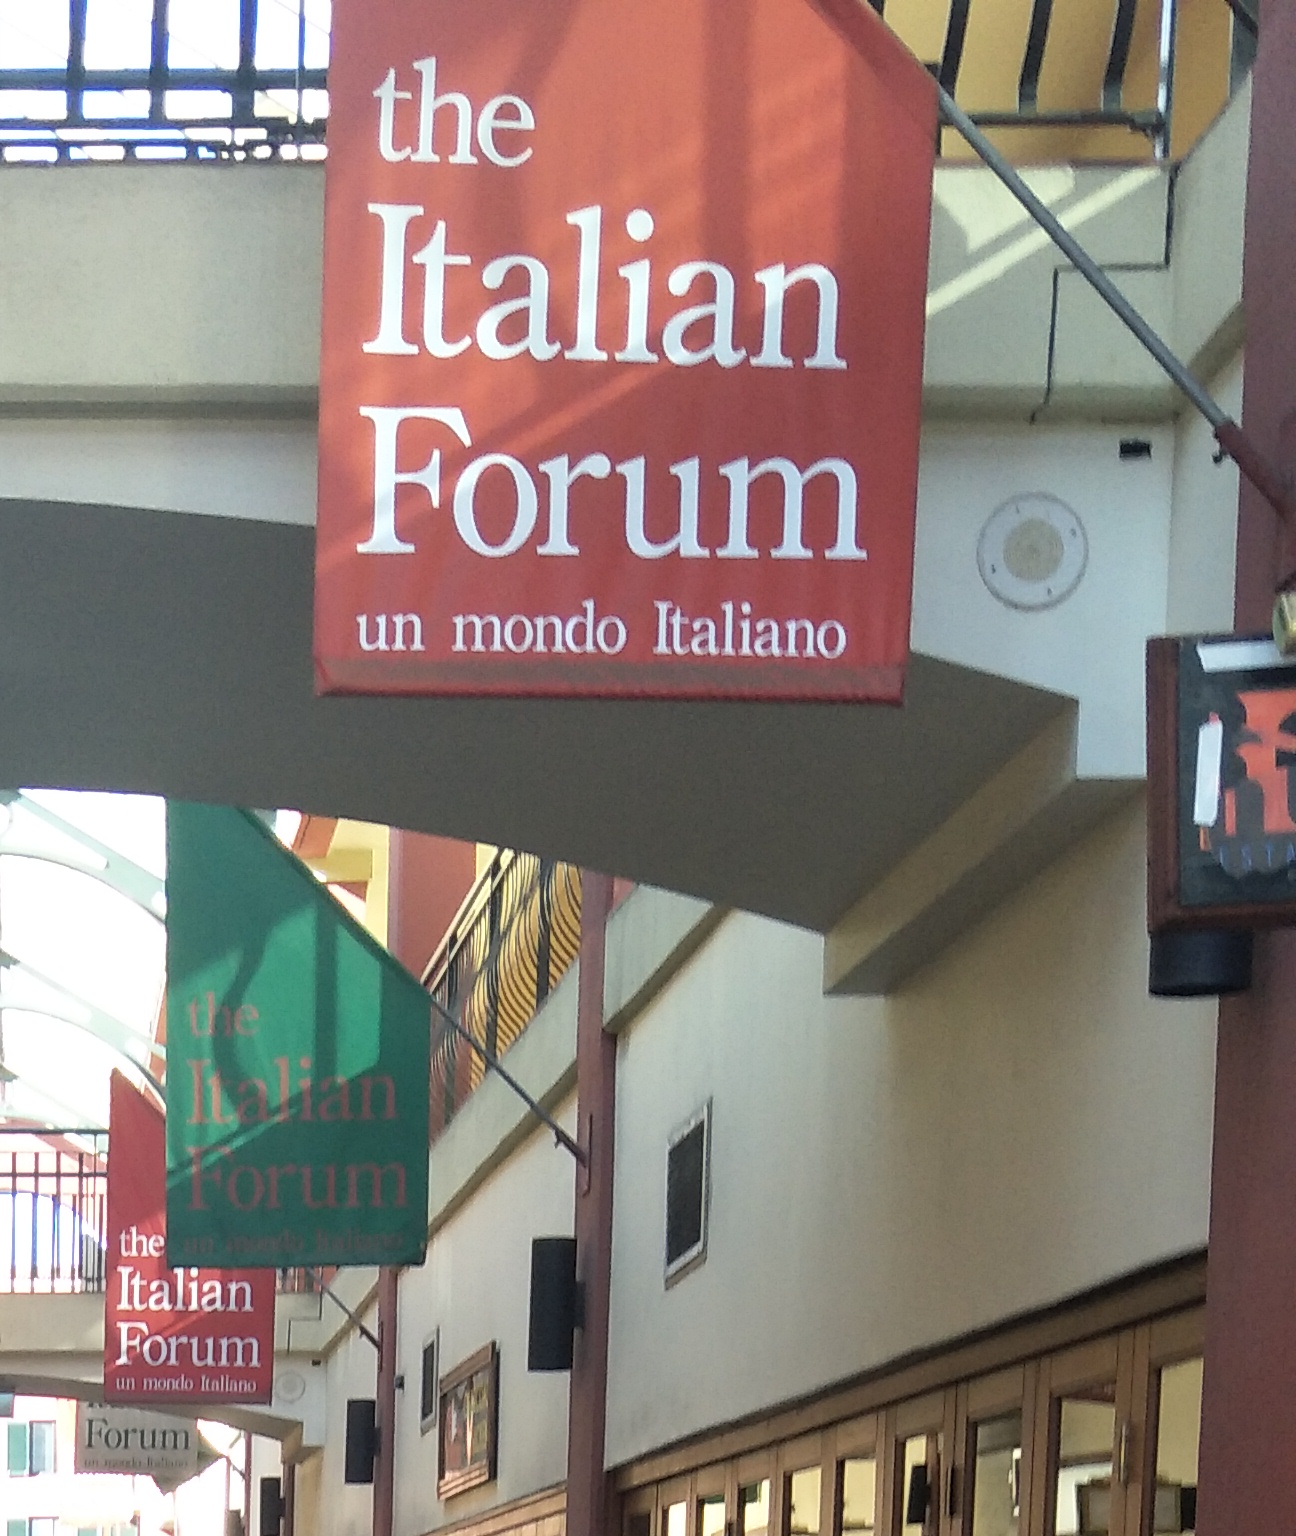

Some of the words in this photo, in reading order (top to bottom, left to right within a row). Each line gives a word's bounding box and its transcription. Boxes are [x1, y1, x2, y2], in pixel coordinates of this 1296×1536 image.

[372, 56, 536, 168] the
[361, 202, 848, 370] Italian
[355, 405, 868, 561] Forum
[356, 612, 425, 655] un
[451, 600, 627, 658] mondo
[652, 600, 847, 660] Italiano
[187, 990, 259, 1037] the
[186, 1055, 401, 1126] Italian
[185, 1145, 411, 1212] Forum
[119, 1225, 165, 1258] the
[116, 1265, 254, 1313] Italian
[115, 1320, 261, 1368] Forum
[116, 1376, 135, 1391] un
[143, 1374, 194, 1391] mondo
[201, 1374, 257, 1393] Italiano
[85, 1417, 190, 1451] Forum
